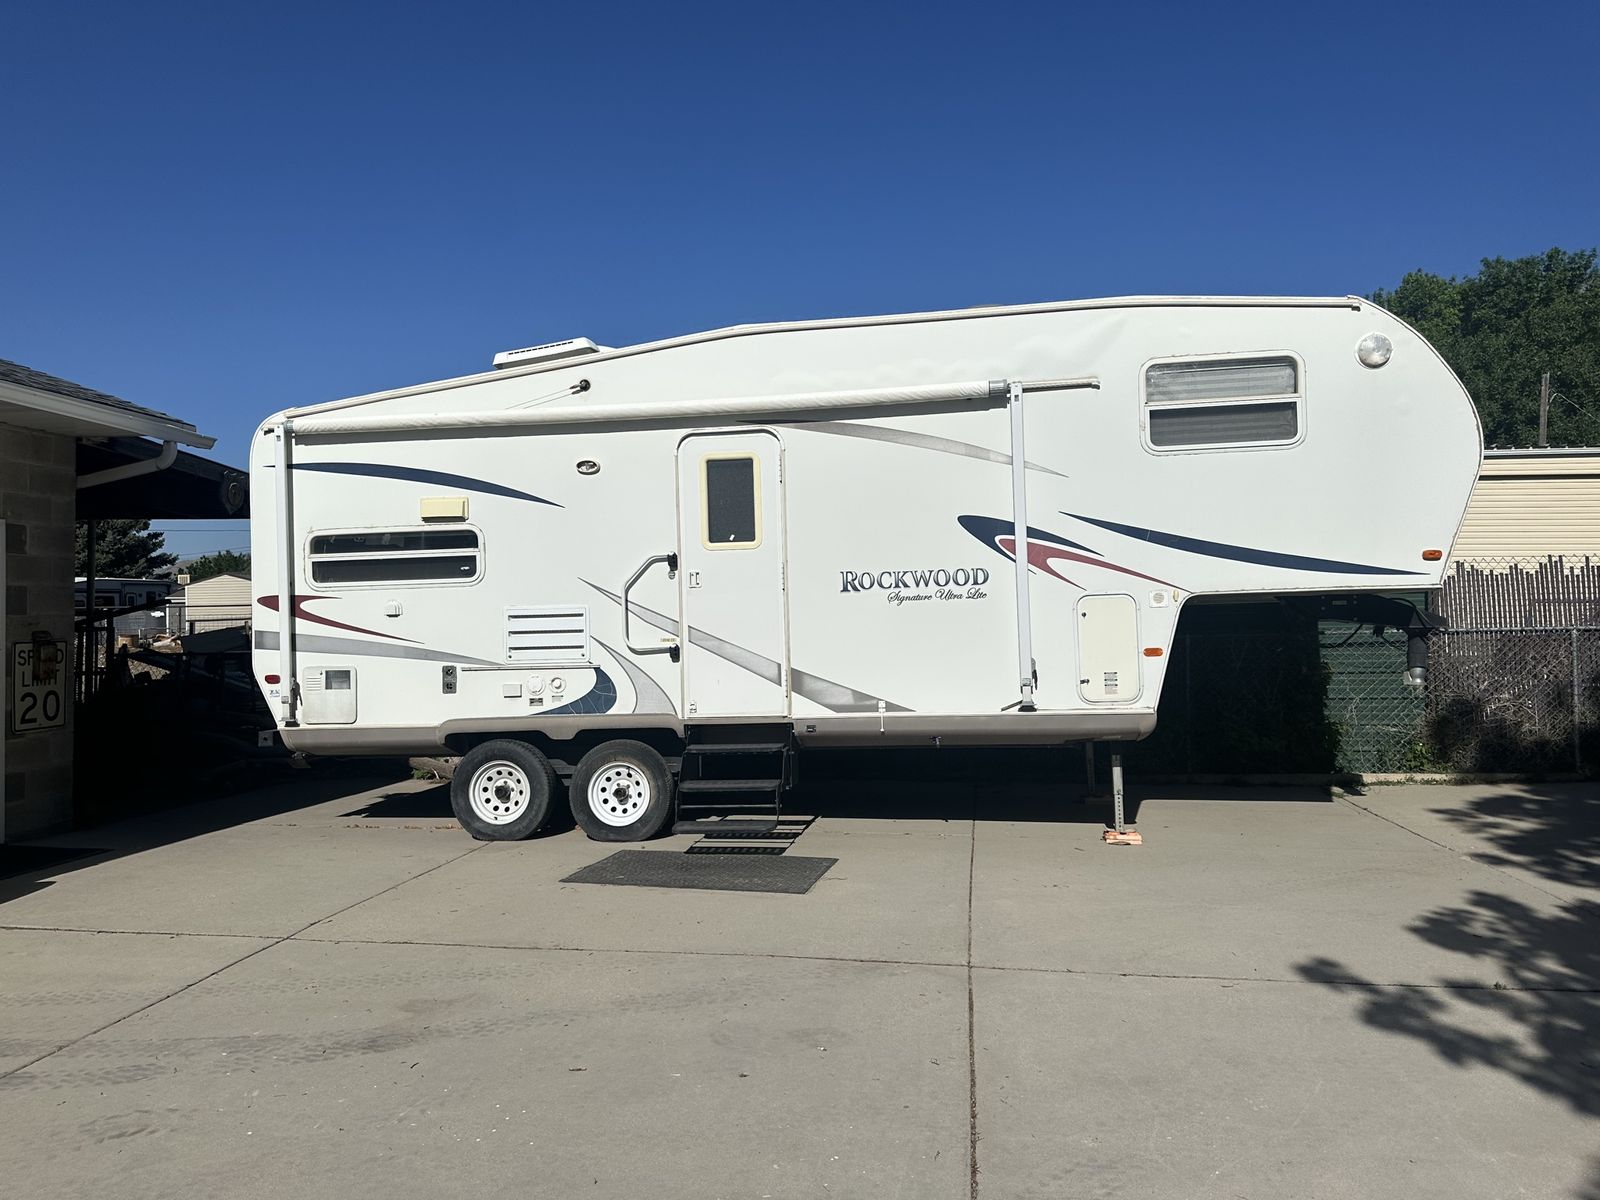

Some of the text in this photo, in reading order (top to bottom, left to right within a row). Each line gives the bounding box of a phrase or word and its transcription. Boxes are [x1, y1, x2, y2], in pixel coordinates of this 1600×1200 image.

[840, 567, 990, 593] ROCKWOOD
[887, 587, 988, 606] Signature Ultra Lite
[17, 648, 64, 666] SPD
[20, 690, 60, 725] 20
